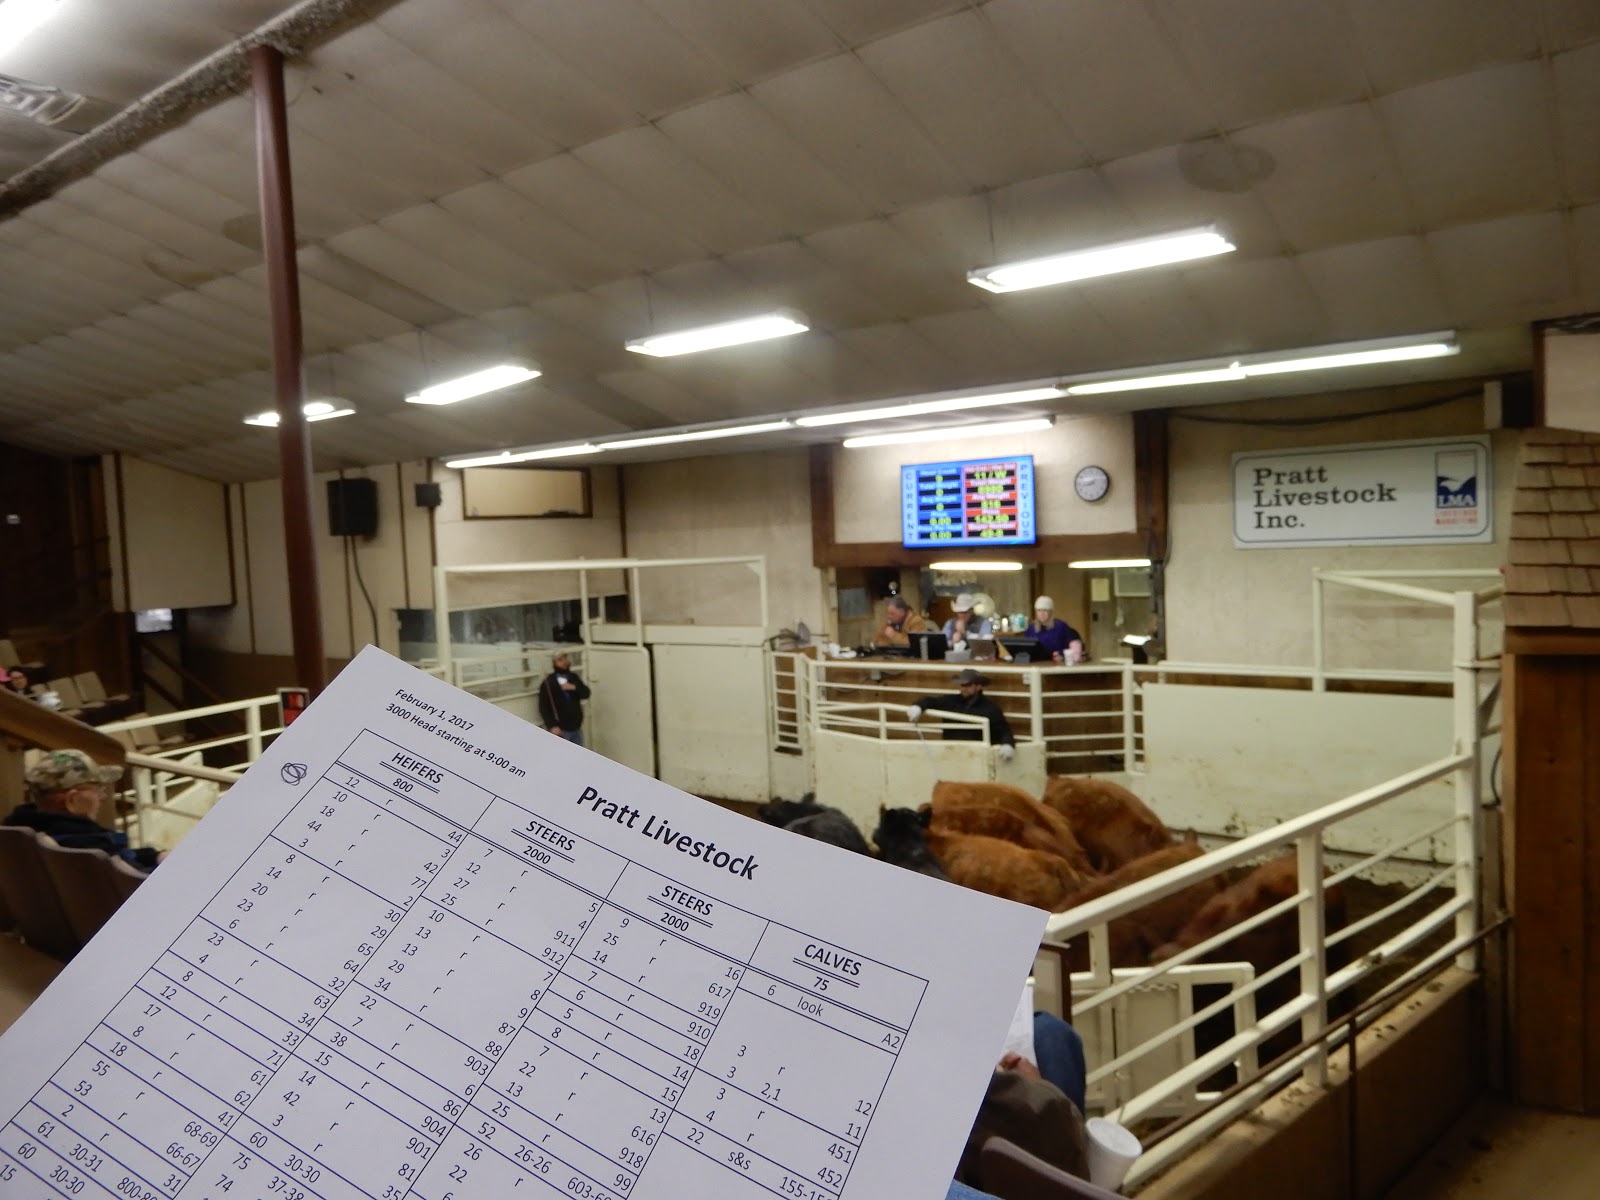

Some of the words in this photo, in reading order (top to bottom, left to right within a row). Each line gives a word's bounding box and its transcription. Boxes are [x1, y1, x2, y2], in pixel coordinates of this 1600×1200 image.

[1253, 466, 1328, 486] Pratt
[1253, 483, 1397, 508] Livestock
[1438, 494, 1475, 507] LMA
[1254, 511, 1305, 529] Inc.
[386, 702, 411, 720] 3000
[410, 714, 438, 733] Head
[436, 728, 474, 753] starting
[474, 746, 486, 758] at
[485, 752, 510, 769] 9:00
[508, 765, 527, 778] am
[395, 688, 438, 716] February
[437, 710, 446, 721] 1,
[448, 714, 474, 731] 2017
[391, 752, 444, 784] HEIFERS
[392, 777, 414, 793] 800
[319, 805, 335, 817] 18
[423, 862, 439, 875] 42
[332, 791, 348, 802] 10
[441, 848, 451, 858] 3
[345, 776, 360, 789] 12
[447, 831, 463, 843] 44
[525, 820, 576, 851] STEERS
[576, 786, 641, 829] Pratt
[641, 815, 759, 880] Livestock
[285, 854, 296, 864] 8
[384, 909, 401, 923] 30
[298, 838, 309, 848] 3
[403, 896, 414, 907] 2
[307, 820, 322, 832] 44
[411, 876, 427, 889] 77
[484, 848, 494, 857] 7
[588, 902, 599, 913] 5
[523, 845, 551, 865] 2000
[251, 882, 268, 896] 20
[357, 943, 374, 957] 65
[266, 867, 282, 880] 14
[370, 925, 388, 939] 29
[440, 893, 458, 906] 25
[541, 947, 565, 966] 912
[453, 877, 470, 889] 27
[553, 930, 576, 949] 911
[465, 862, 481, 875] 12
[578, 920, 587, 930] 4
[660, 912, 690, 932] 2000
[661, 885, 713, 916] STEERS
[207, 932, 224, 946] 23
[313, 994, 331, 1009] 63
[228, 919, 240, 929] 6
[328, 976, 345, 992] 32
[237, 898, 254, 912] 23
[343, 959, 360, 974] 64
[415, 926, 431, 939] 13
[530, 989, 541, 1001] 8
[428, 909, 445, 923] 10
[543, 970, 554, 981] 7
[603, 932, 619, 946] 25
[708, 982, 732, 999] 617
[620, 918, 630, 928] 9
[725, 966, 741, 981] 16
[804, 944, 862, 976] CALVES
[182, 970, 194, 982] 8
[282, 1031, 300, 1047] 33
[199, 954, 209, 964] 4
[297, 1012, 316, 1028] 34
[374, 977, 391, 992] 34
[484, 1041, 503, 1057] 88
[388, 959, 405, 974] 29
[498, 1022, 516, 1037] 87
[401, 943, 418, 956] 13
[517, 1007, 528, 1019] 9
[587, 970, 598, 982] 7
[687, 1021, 711, 1040] 910
[592, 950, 608, 964] 14
[697, 1001, 721, 1020] 919
[767, 984, 777, 996] 6
[797, 996, 824, 1017] look
[881, 1033, 900, 1049] A2
[813, 976, 830, 991] 75
[143, 1004, 162, 1017] 17
[250, 1070, 267, 1086] 61
[159, 986, 177, 1001] 12
[266, 1049, 284, 1067] 71
[352, 1016, 363, 1027] 7
[464, 1084, 476, 1096] 6
[359, 995, 377, 1010] 22
[464, 1055, 489, 1076] 903
[563, 1007, 574, 1020] 5
[672, 1066, 689, 1082] 14
[575, 990, 586, 1001] 6
[683, 1045, 700, 1061] 18
[109, 1041, 128, 1057] 18
[217, 1111, 234, 1127] 41
[132, 1026, 144, 1038] 8
[234, 1090, 251, 1107] 62
[314, 1051, 333, 1066] 15
[421, 1115, 447, 1138] 904
[329, 1031, 348, 1047] 38
[442, 1099, 462, 1117] 86
[539, 1045, 550, 1057] 7
[649, 1108, 667, 1124] 13
[551, 1026, 562, 1039] 8
[661, 1087, 679, 1102] 15
[737, 1045, 747, 1057] 3
[855, 1100, 872, 1117] 12
[74, 1080, 93, 1096] 53
[166, 1142, 201, 1168] 66-67
[92, 1060, 111, 1076] 55
[184, 1121, 218, 1148] 68-69
[272, 1114, 284, 1127] 3
[283, 1091, 300, 1107] 42
[398, 1163, 416, 1182] 81
[298, 1070, 317, 1086] 14
[406, 1137, 431, 1160] 901
[505, 1081, 523, 1098] 13
[618, 1147, 644, 1169] 918
[518, 1061, 536, 1078] 22
[631, 1125, 656, 1146] 616
[716, 1087, 726, 1100] 3
[827, 1143, 852, 1164] 451
[726, 1066, 736, 1079] 3
[760, 1082, 781, 1102] 2,1
[845, 1123, 862, 1140] 11
[17, 1142, 37, 1159] 60
[49, 1165, 85, 1194] 30-30
[37, 1121, 55, 1139] 61
[69, 1143, 103, 1173] 30-31
[61, 1104, 74, 1117] 2
[163, 1174, 182, 1193] 31
[232, 1152, 252, 1170] 75
[249, 1131, 268, 1149] 60
[284, 1154, 321, 1183] 30-30
[448, 1164, 468, 1183] 22
[463, 1142, 483, 1161] 26
[477, 1121, 496, 1140] 52
[514, 1144, 552, 1174] 26-26
[491, 1101, 511, 1118] 25
[613, 1173, 632, 1191] 99
[687, 1127, 704, 1145] 22
[727, 1151, 751, 1170] s&s
[705, 1110, 715, 1123] 4
[817, 1167, 843, 1189] 452
[215, 1173, 234, 1193] 74
